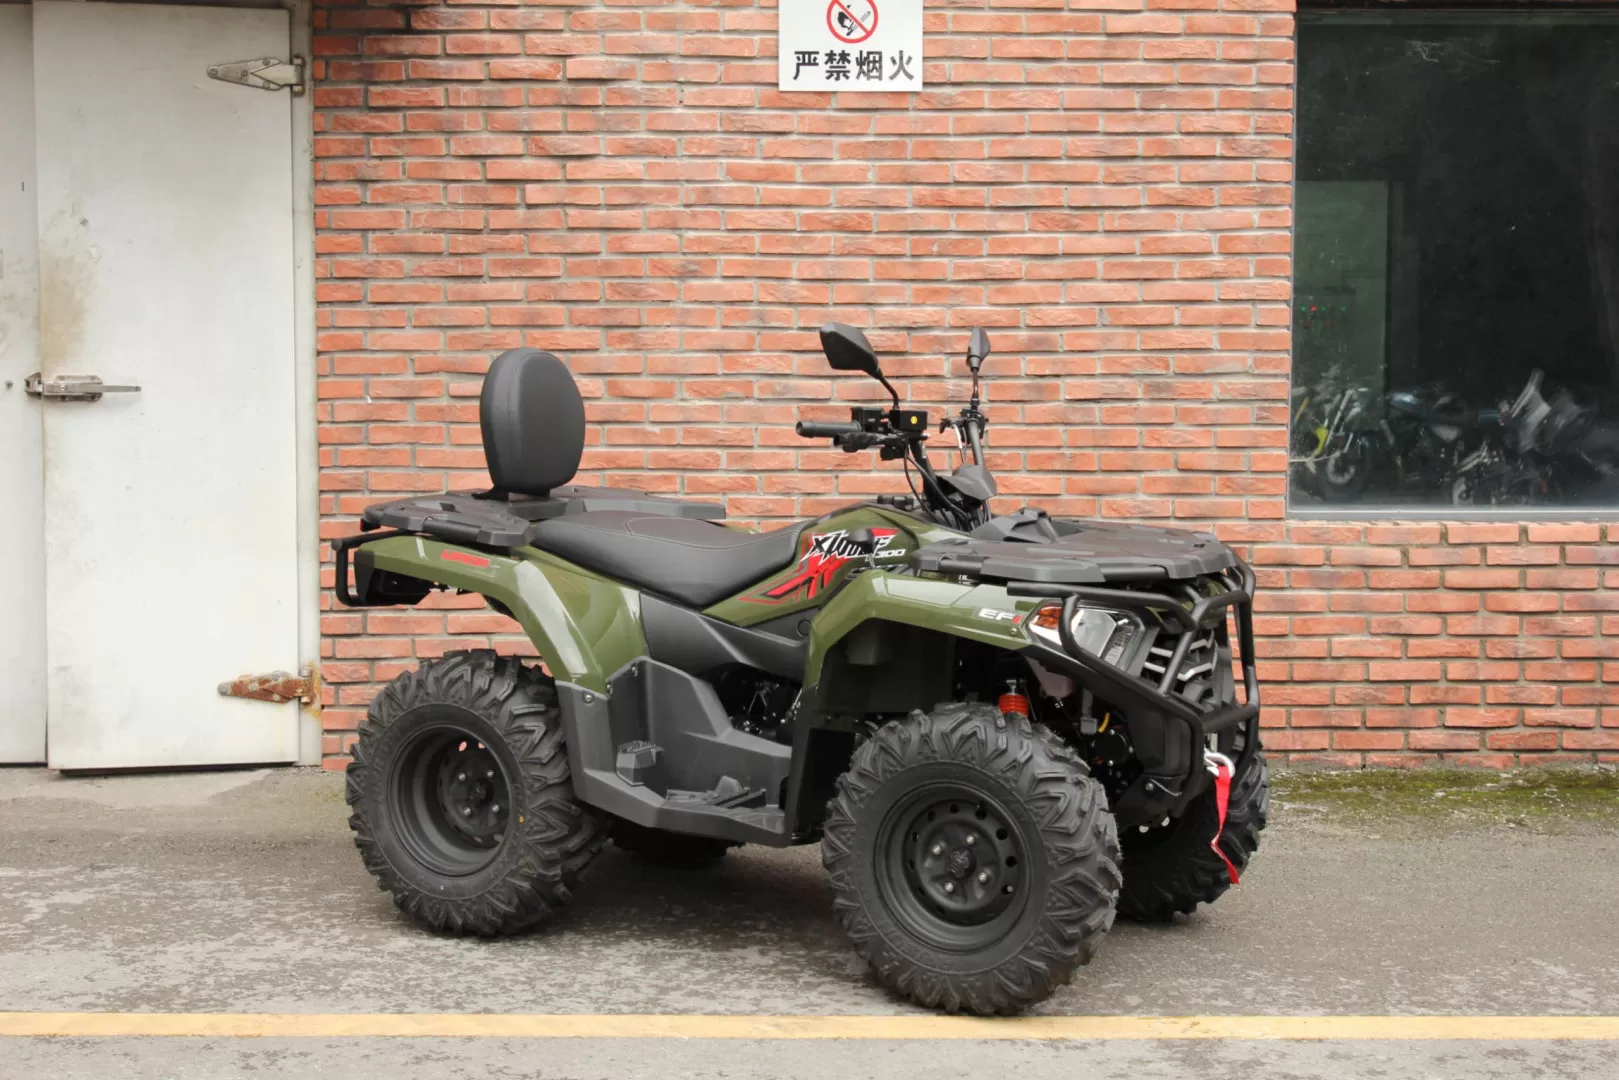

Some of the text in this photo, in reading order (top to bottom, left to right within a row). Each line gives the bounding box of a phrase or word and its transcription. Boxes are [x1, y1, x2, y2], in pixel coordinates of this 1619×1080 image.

[793, 50, 915, 81] 严禁烟火
[875, 548, 906, 559] 300
